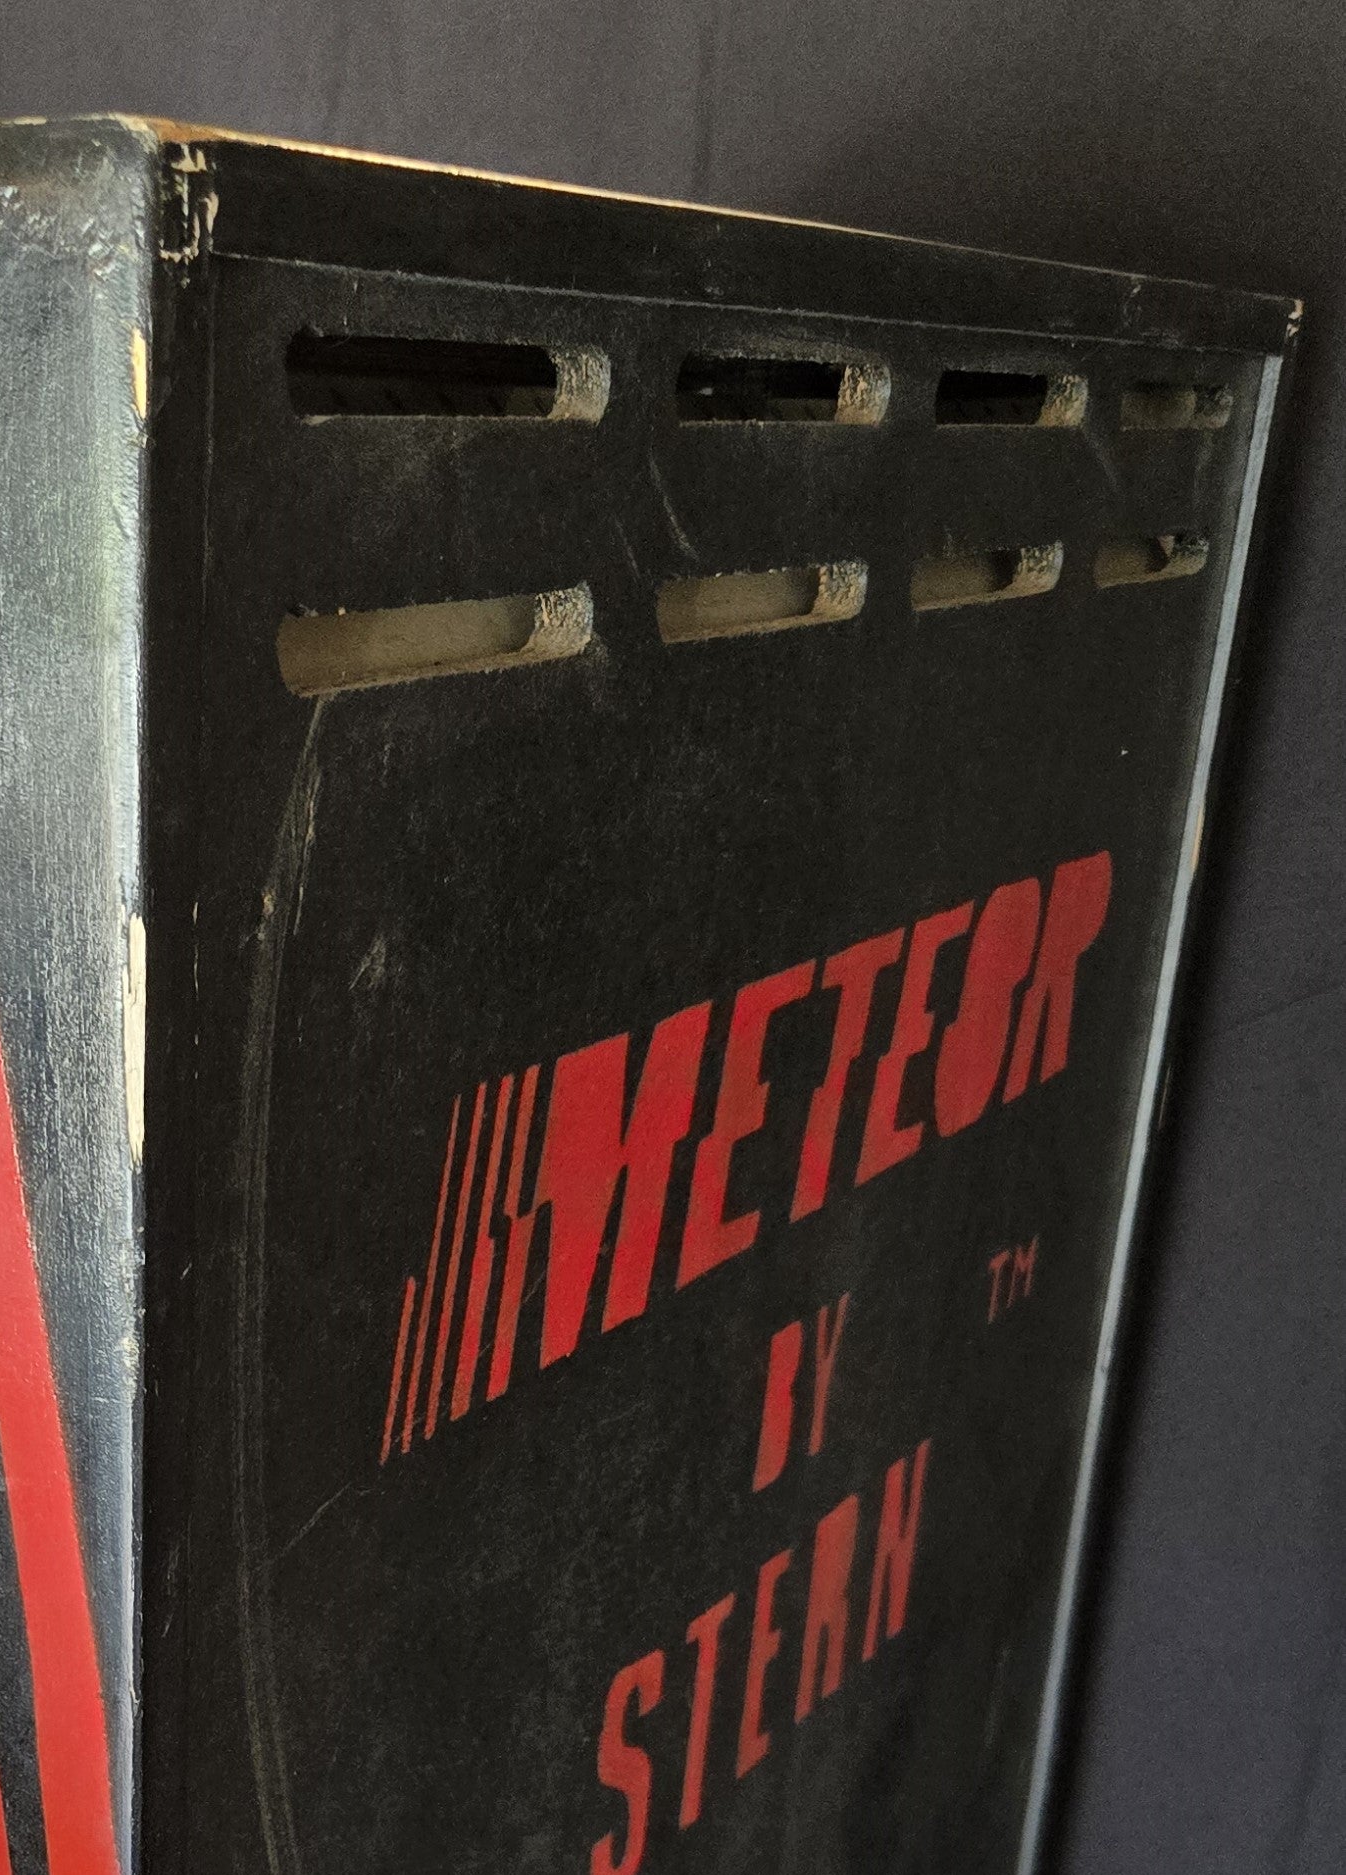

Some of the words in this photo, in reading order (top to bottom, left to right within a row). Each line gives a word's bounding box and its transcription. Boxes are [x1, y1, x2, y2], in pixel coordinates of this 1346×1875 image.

[380, 850, 1113, 1465] METEOR
[987, 1235, 1039, 1323] TM
[753, 1292, 850, 1493] BY
